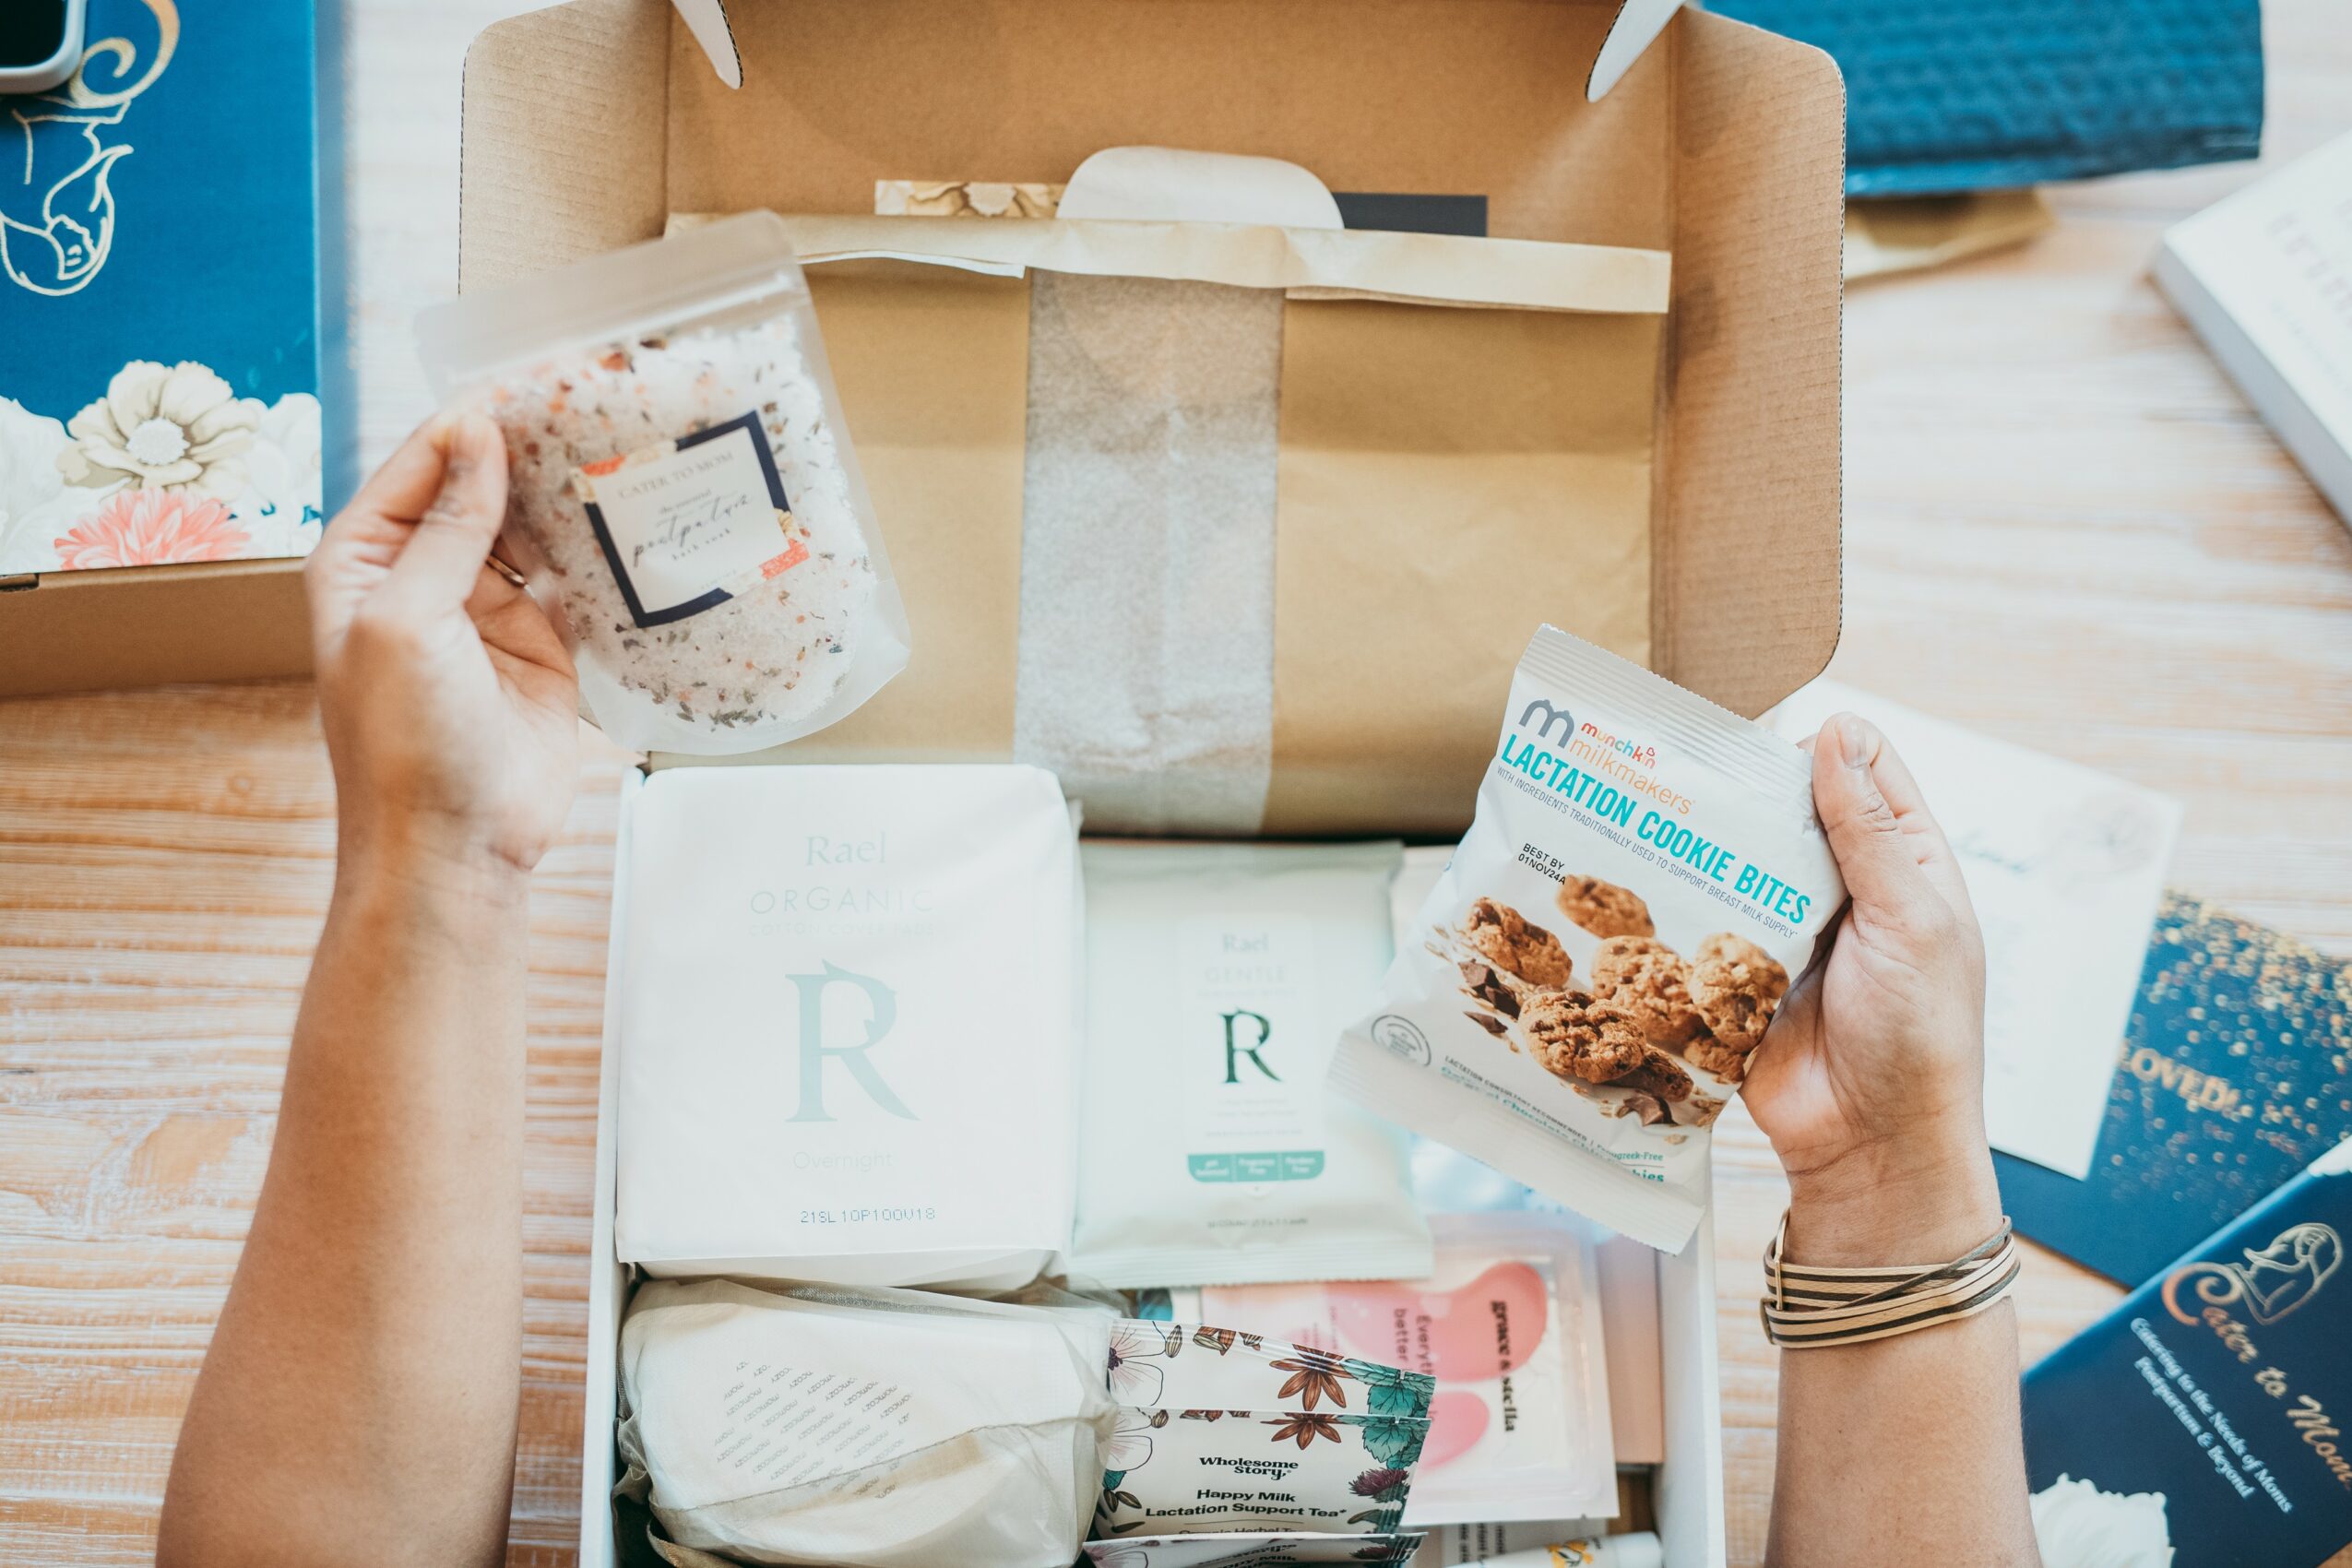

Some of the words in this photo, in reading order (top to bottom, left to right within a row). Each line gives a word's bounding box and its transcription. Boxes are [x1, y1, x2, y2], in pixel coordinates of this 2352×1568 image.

[1581, 722, 1656, 769] munchkin
[1497, 766, 1515, 784] WITH
[1515, 778, 1569, 814] INGREDIENTS
[1569, 808, 1632, 849] TRADITIONALLY
[1632, 842, 1656, 862] USED
[1657, 856, 1669, 869] TO
[1668, 863, 1709, 891] SUPPORT
[1707, 885, 1742, 909] BREAST
[1740, 904, 1764, 922] MILK
[1501, 733, 1637, 828] LACTATION
[1637, 811, 1736, 882] COOKIE
[1733, 863, 1812, 924] BITES
[804, 831, 886, 866] Rael
[1522, 843, 1550, 863] BEST
[1550, 858, 1565, 871] BY
[1518, 853, 1567, 885] 01NOV24A
[751, 885, 933, 914] ORGANIC
[1221, 932, 1269, 953] Rael
[784, 957, 922, 1123] R
[1218, 1006, 1284, 1085] R
[1444, 1054, 1483, 1082] LACTATION
[793, 1150, 893, 1172] Overnight
[1394, 1308, 1409, 1362] better
[1491, 1300, 1511, 1356] grace
[1502, 1376, 1518, 1432] stella
[2254, 1367, 2288, 1399] to
[2131, 1317, 2184, 1379] Catering
[2178, 1373, 2196, 1393] to
[2191, 1389, 2215, 1417] the
[2209, 1411, 2248, 1457] Needs
[2241, 1455, 2265, 1472] of
[2254, 1468, 2294, 1514] Moms
[1200, 1456, 1299, 1469] Wholesome
[2207, 1445, 2256, 1499] Beyond
[1145, 1503, 1228, 1517] Lactation
[1232, 1503, 1304, 1515] Support
[1197, 1489, 1253, 1502] Happy
[1258, 1491, 1296, 1503] Milk
